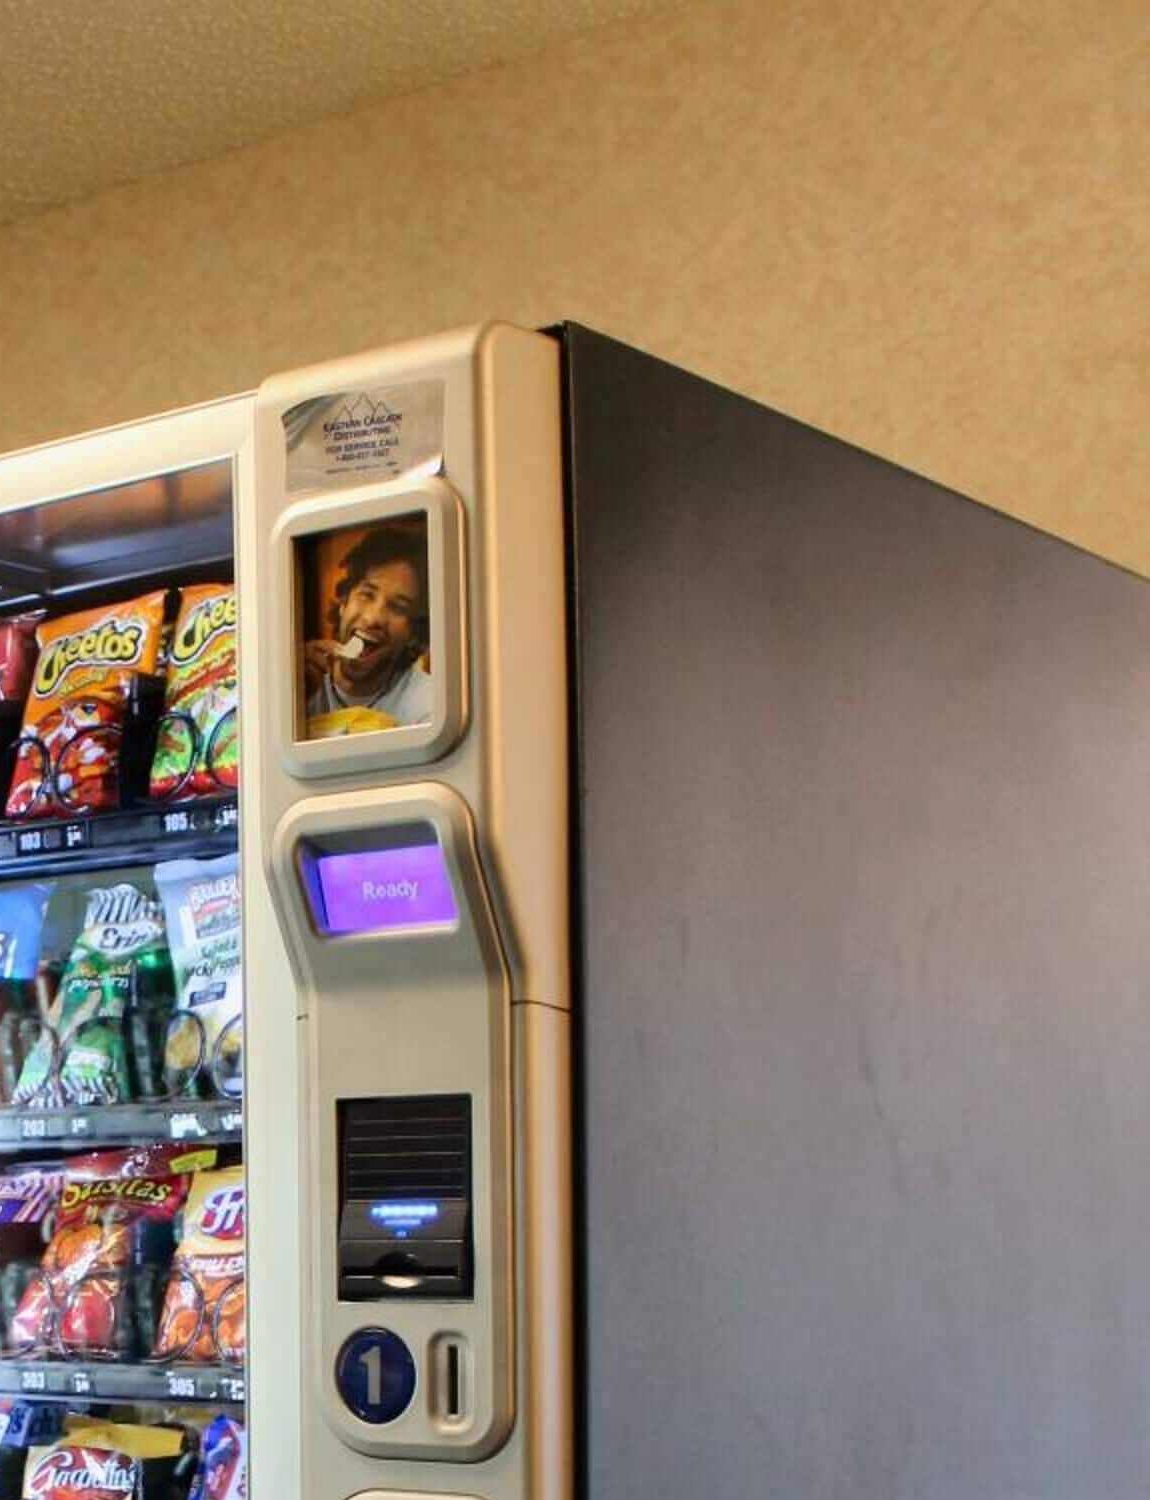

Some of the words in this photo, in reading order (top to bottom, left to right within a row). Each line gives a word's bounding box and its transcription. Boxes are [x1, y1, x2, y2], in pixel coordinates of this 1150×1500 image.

[37, 622, 139, 695] Cheetos
[362, 879, 419, 899] Ready
[357, 1344, 382, 1405] 1
